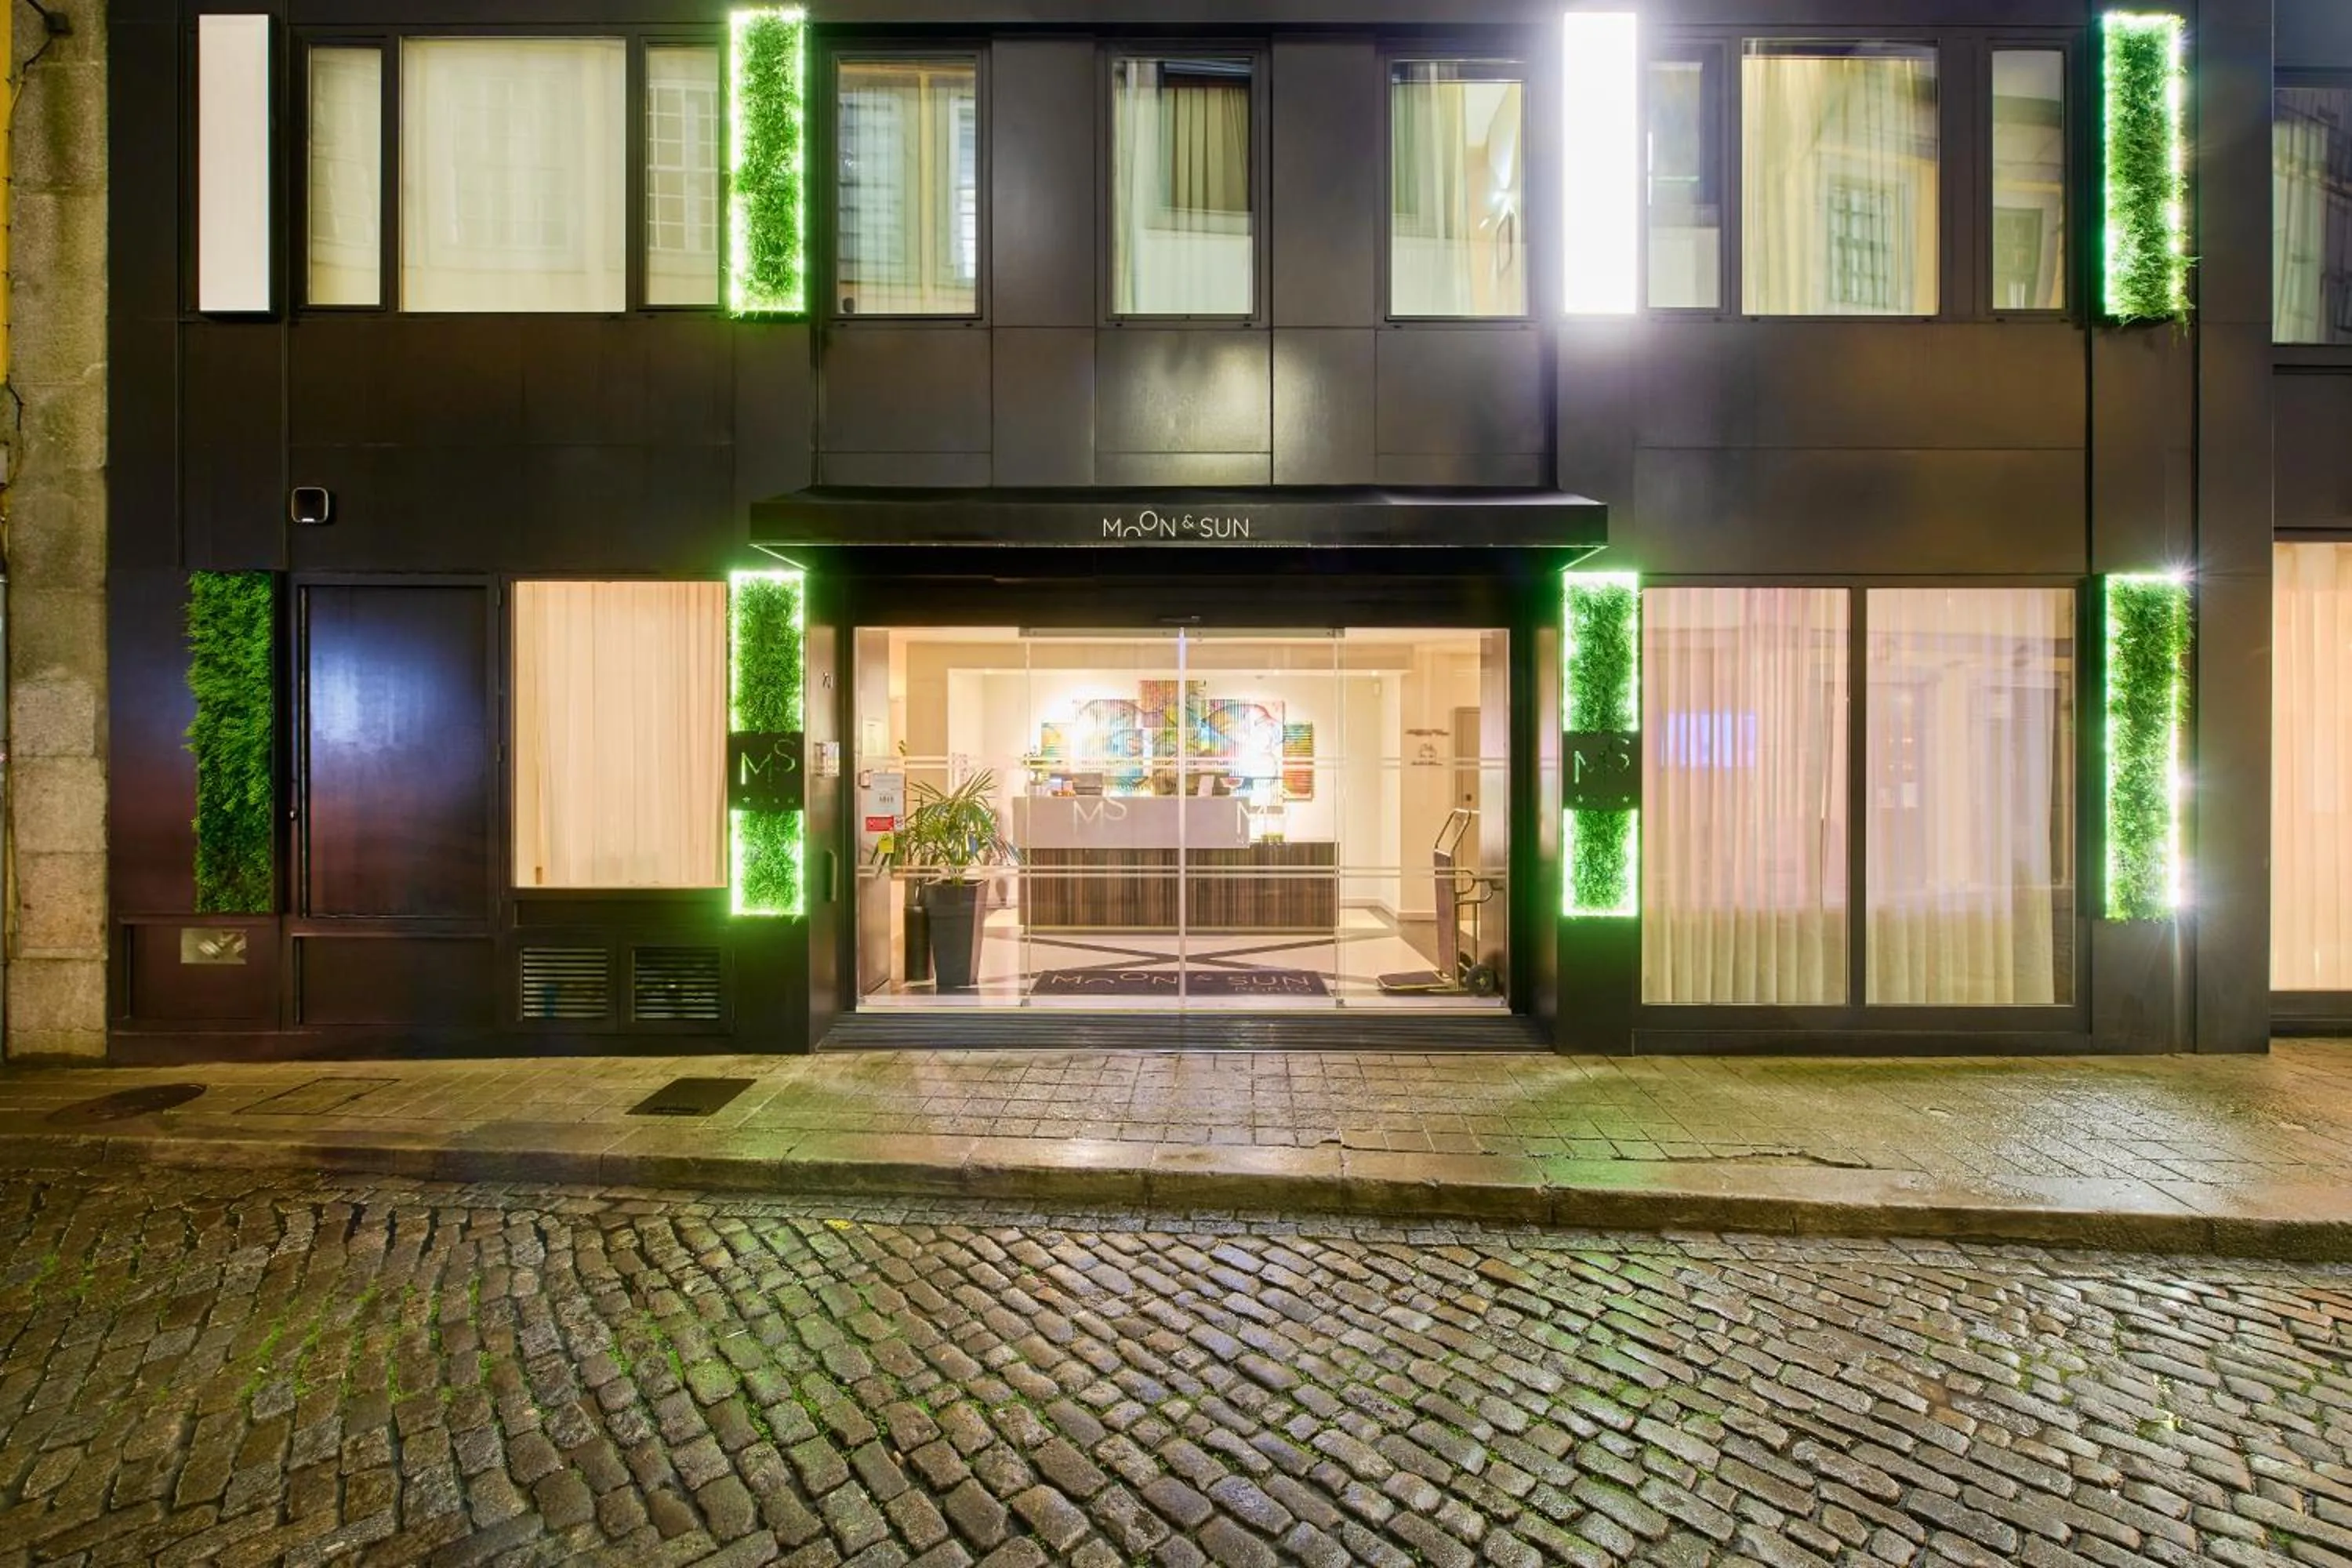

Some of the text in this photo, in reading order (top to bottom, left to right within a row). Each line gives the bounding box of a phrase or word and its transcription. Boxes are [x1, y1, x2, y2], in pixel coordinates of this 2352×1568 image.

[1102, 510, 1249, 538] MOON & SUN
[740, 739, 796, 786] MS
[1073, 793, 1127, 836] MS
[1227, 975, 1309, 985] SUN
